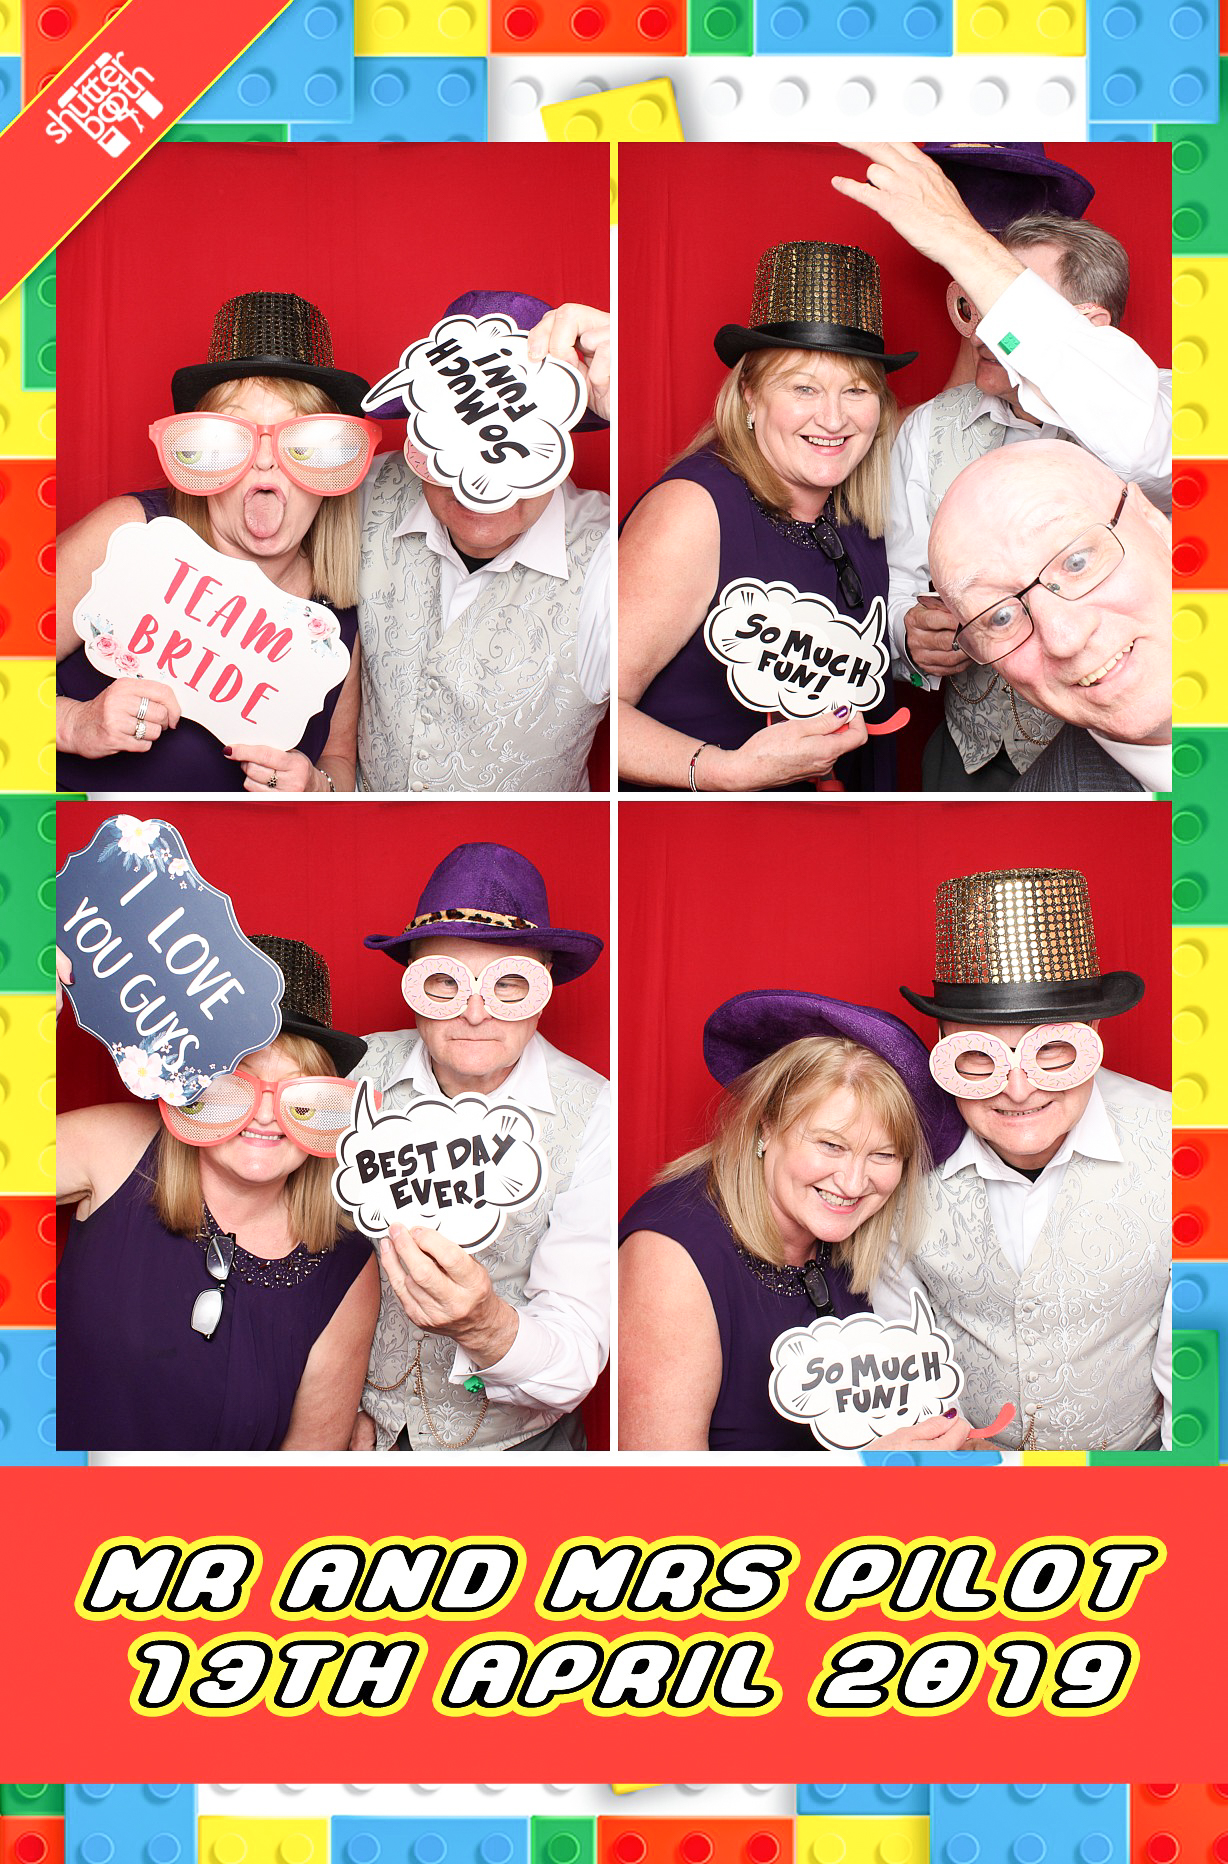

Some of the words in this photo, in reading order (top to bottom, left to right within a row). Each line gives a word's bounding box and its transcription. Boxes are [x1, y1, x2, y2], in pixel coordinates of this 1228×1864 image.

[425, 338, 500, 426] MUCH
[472, 348, 538, 423] FUN!
[479, 424, 531, 464] SO
[164, 558, 293, 663] TEAM
[127, 613, 279, 725] BRIDE
[734, 613, 781, 644] SO
[780, 630, 872, 688] MUCH
[757, 650, 832, 700] FUN!
[120, 869, 158, 907] I
[147, 906, 246, 1021] LOVE
[63, 896, 134, 979] YOU
[119, 974, 200, 1072] GUYS
[355, 1140, 439, 1184] BEST
[446, 1133, 516, 1170] DAY
[389, 1170, 488, 1210] EVER!
[801, 1356, 844, 1392] SO
[850, 1351, 942, 1388] MUCH
[835, 1383, 910, 1416] FUN!
